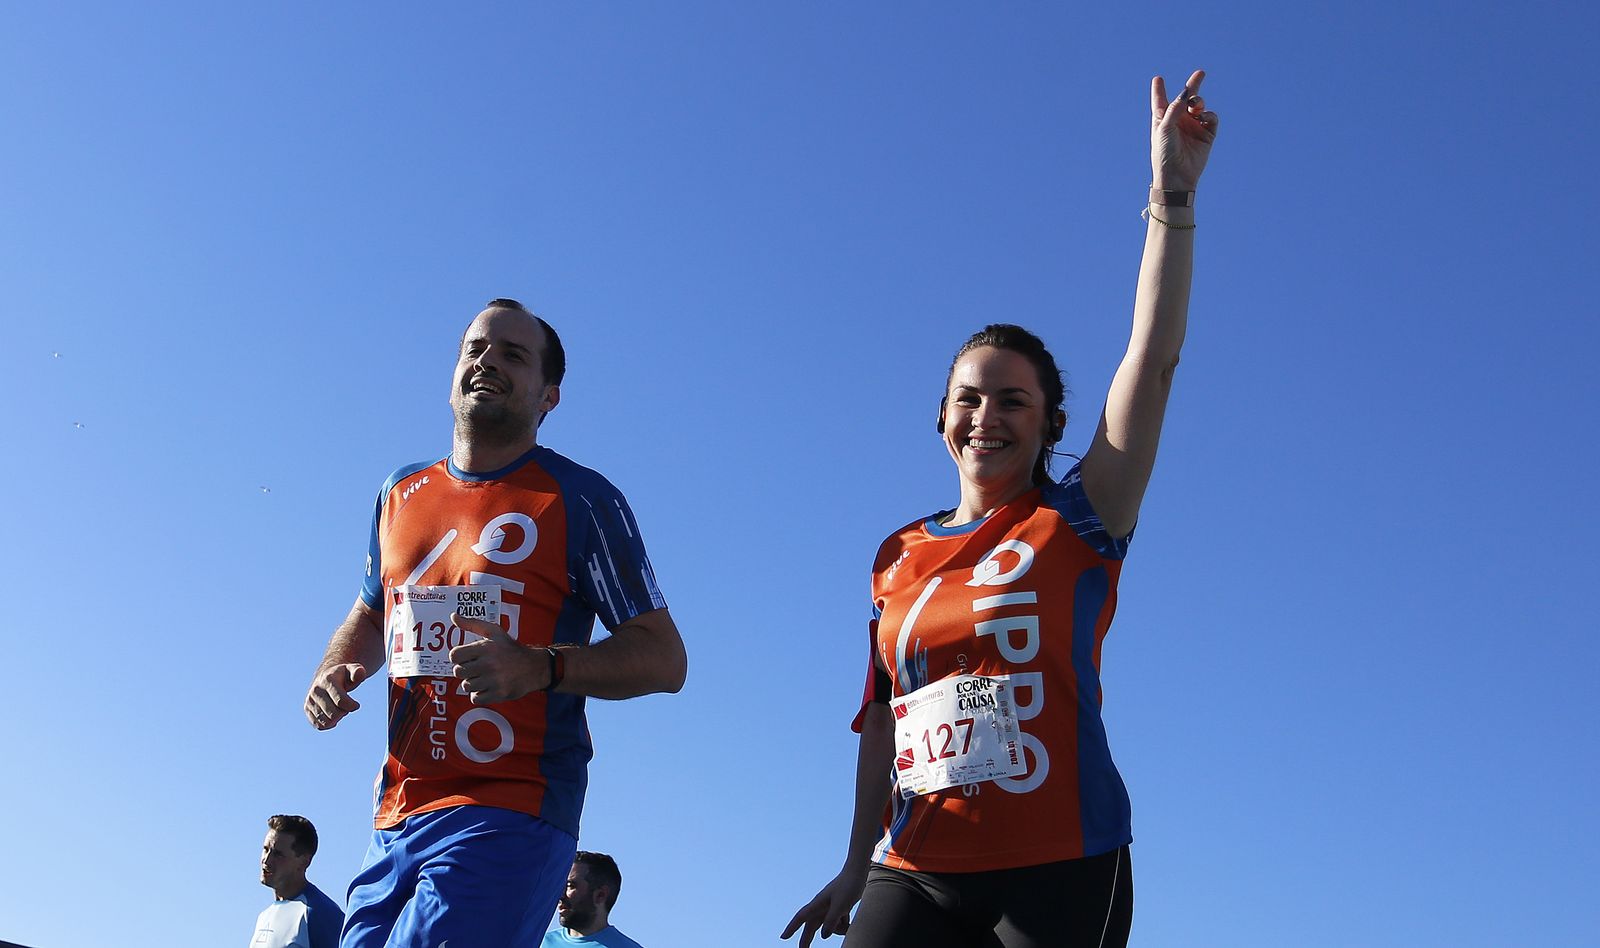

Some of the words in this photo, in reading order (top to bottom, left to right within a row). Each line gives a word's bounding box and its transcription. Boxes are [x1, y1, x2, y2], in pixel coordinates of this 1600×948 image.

[402, 476, 430, 500] vive
[404, 592, 447, 601] ntreculturas
[457, 592, 487, 604] CORRE
[457, 606, 486, 617] CAUSA
[412, 621, 465, 652] 130
[455, 512, 538, 763] QIO
[956, 677, 993, 693] CORRE
[958, 693, 996, 711] CAUSA
[922, 717, 975, 763] 127
